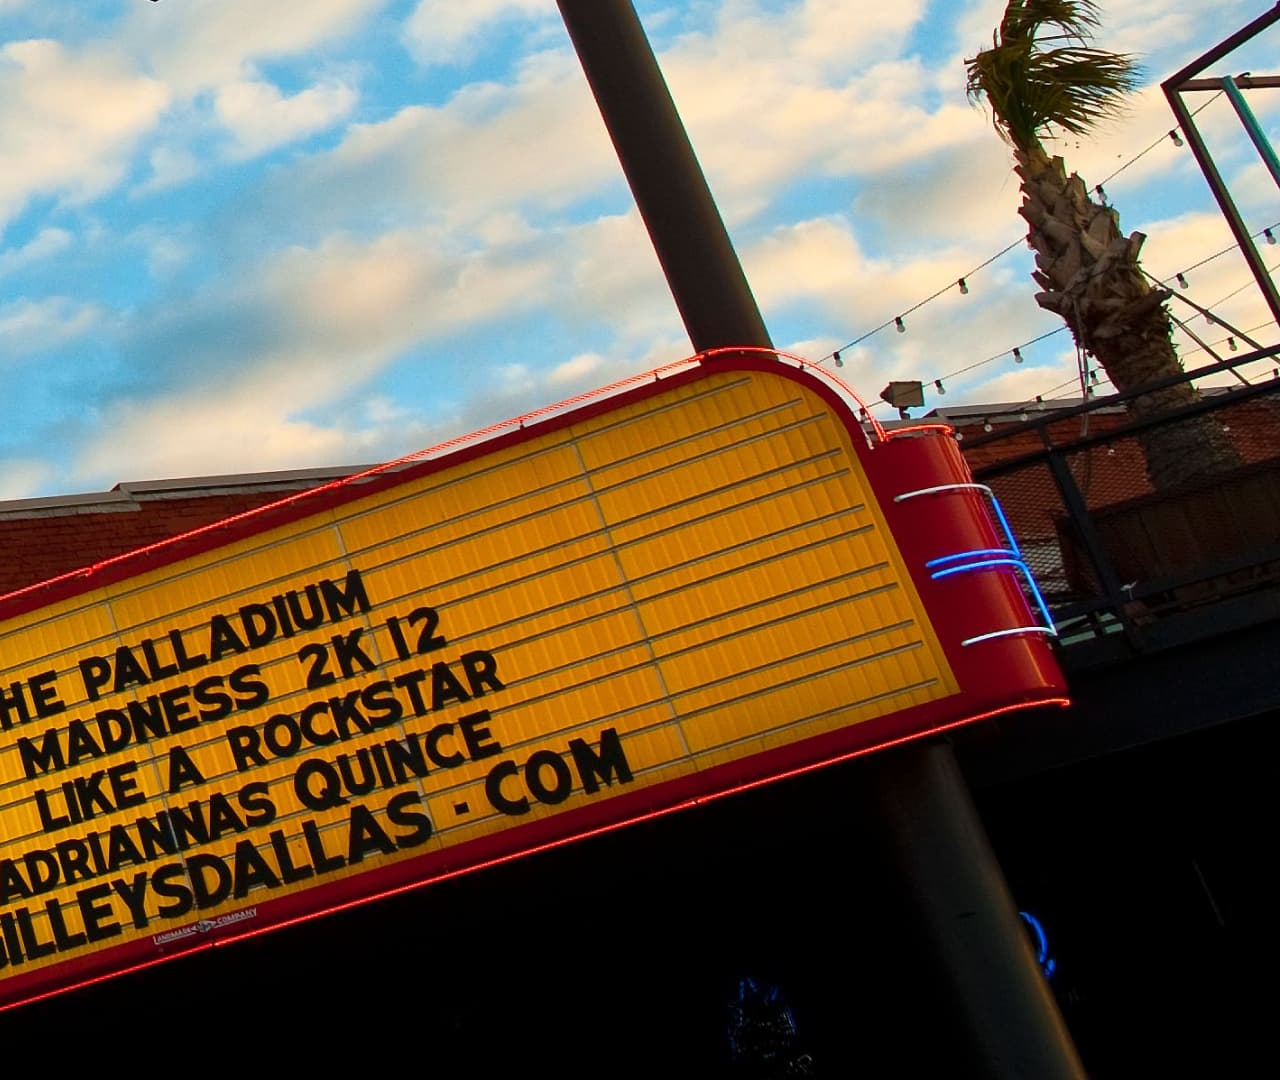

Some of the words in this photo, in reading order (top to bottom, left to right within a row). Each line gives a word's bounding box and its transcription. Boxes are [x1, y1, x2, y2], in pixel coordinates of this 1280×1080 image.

[78, 569, 372, 703] PALLADIUM
[17, 661, 269, 781] MADNESS
[34, 762, 148, 833] LIKE
[166, 746, 208, 794] A
[226, 650, 507, 773] ROCKSTAR
[293, 709, 505, 812] QUINCE
[152, 926, 195, 945] LANDMARK
[216, 907, 257, 926] COMPANY
